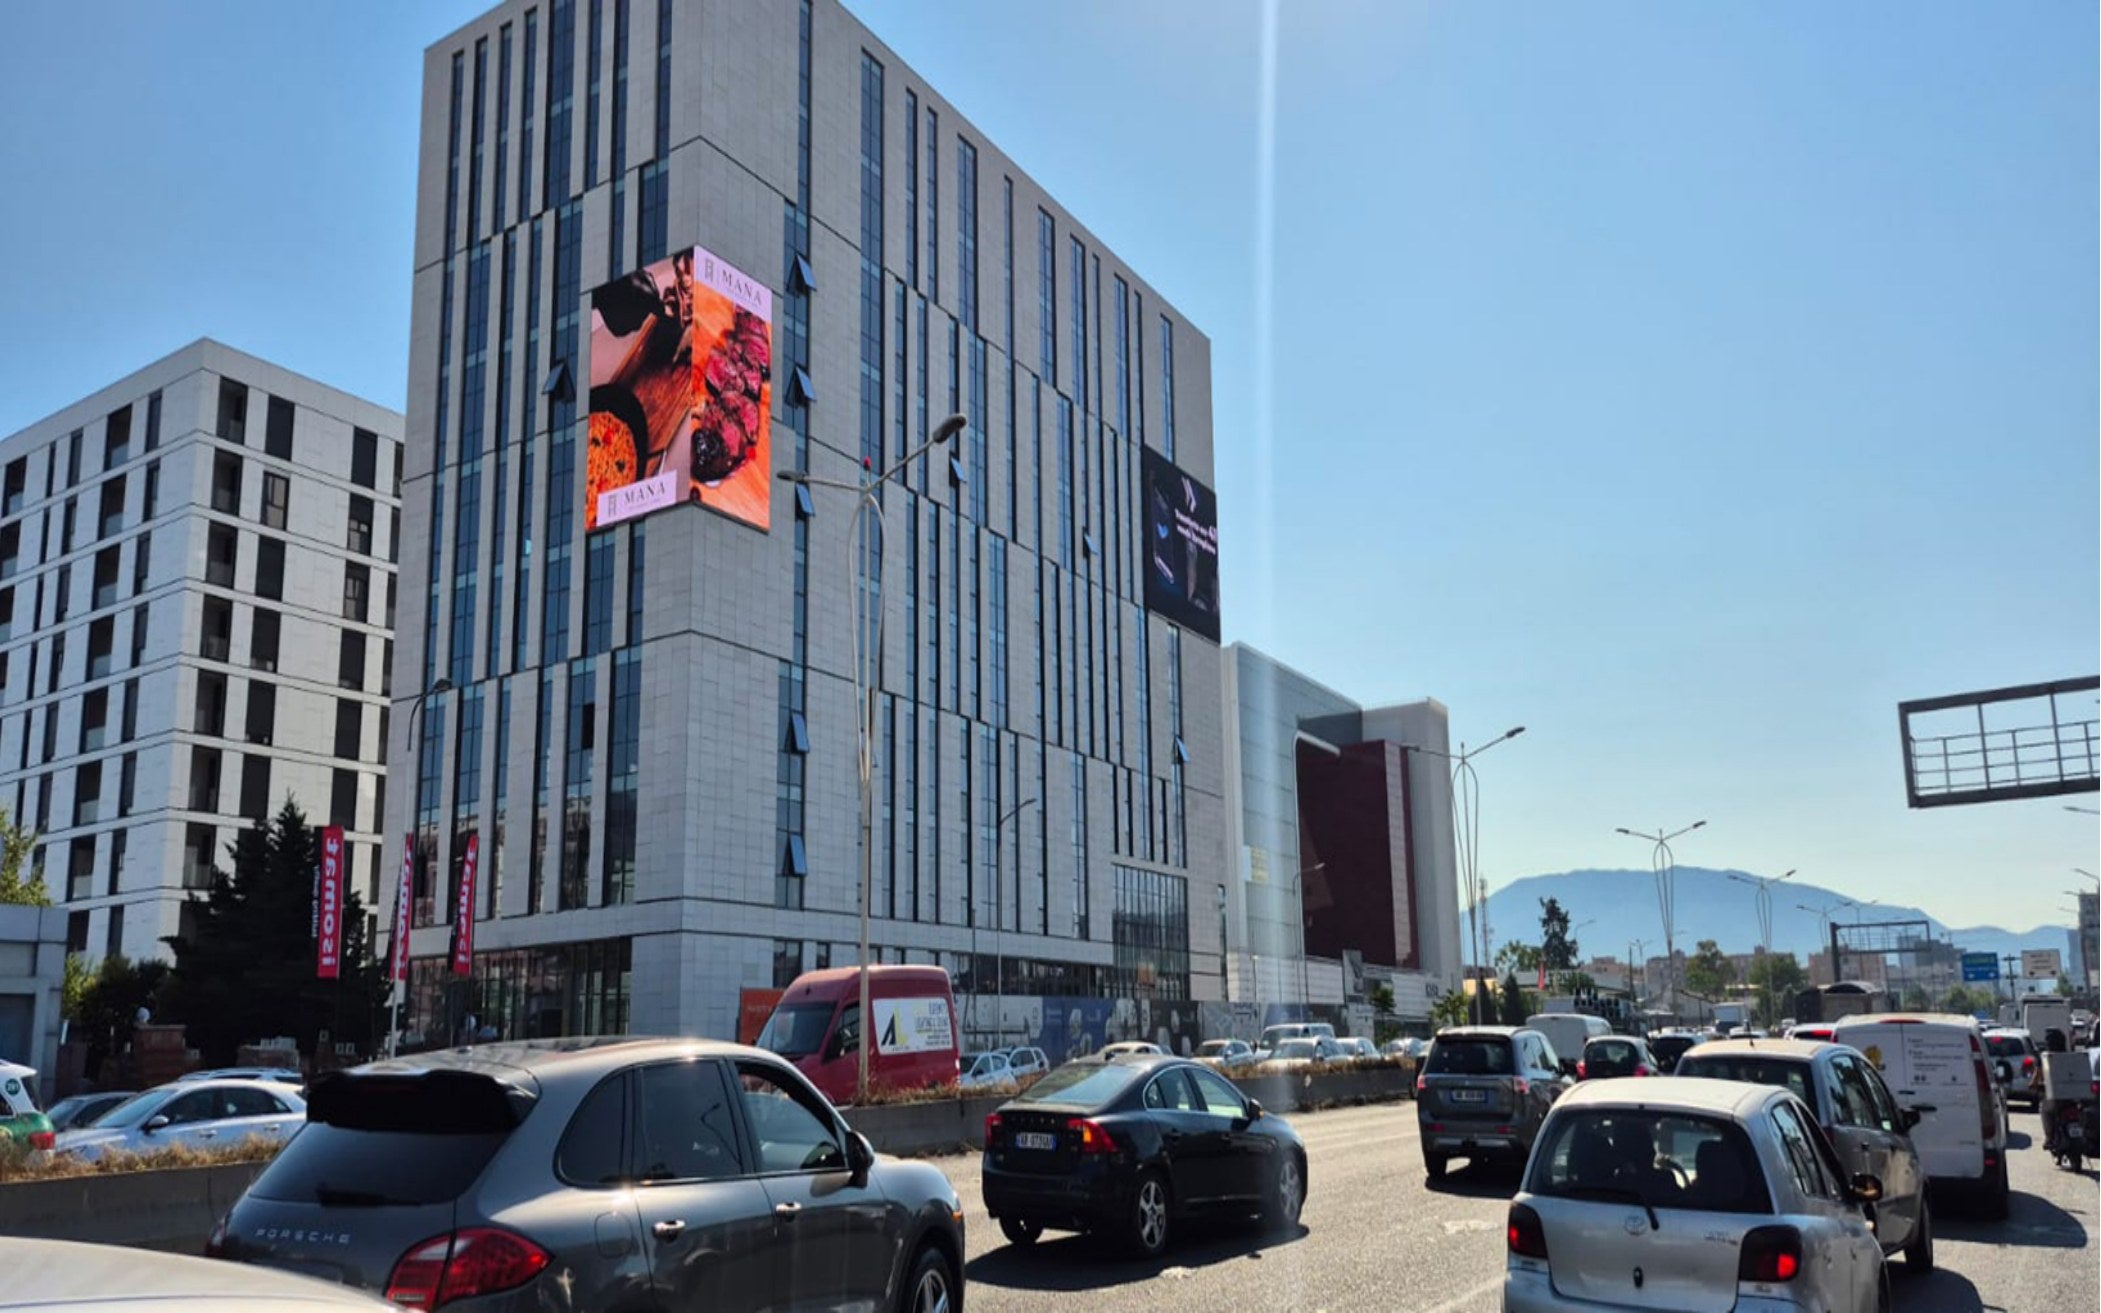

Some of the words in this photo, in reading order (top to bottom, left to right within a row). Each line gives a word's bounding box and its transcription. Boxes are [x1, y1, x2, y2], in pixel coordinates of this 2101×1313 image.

[722, 269, 762, 306] MANA
[624, 482, 665, 504] MANA
[254, 1228, 351, 1244] PORSCHE
